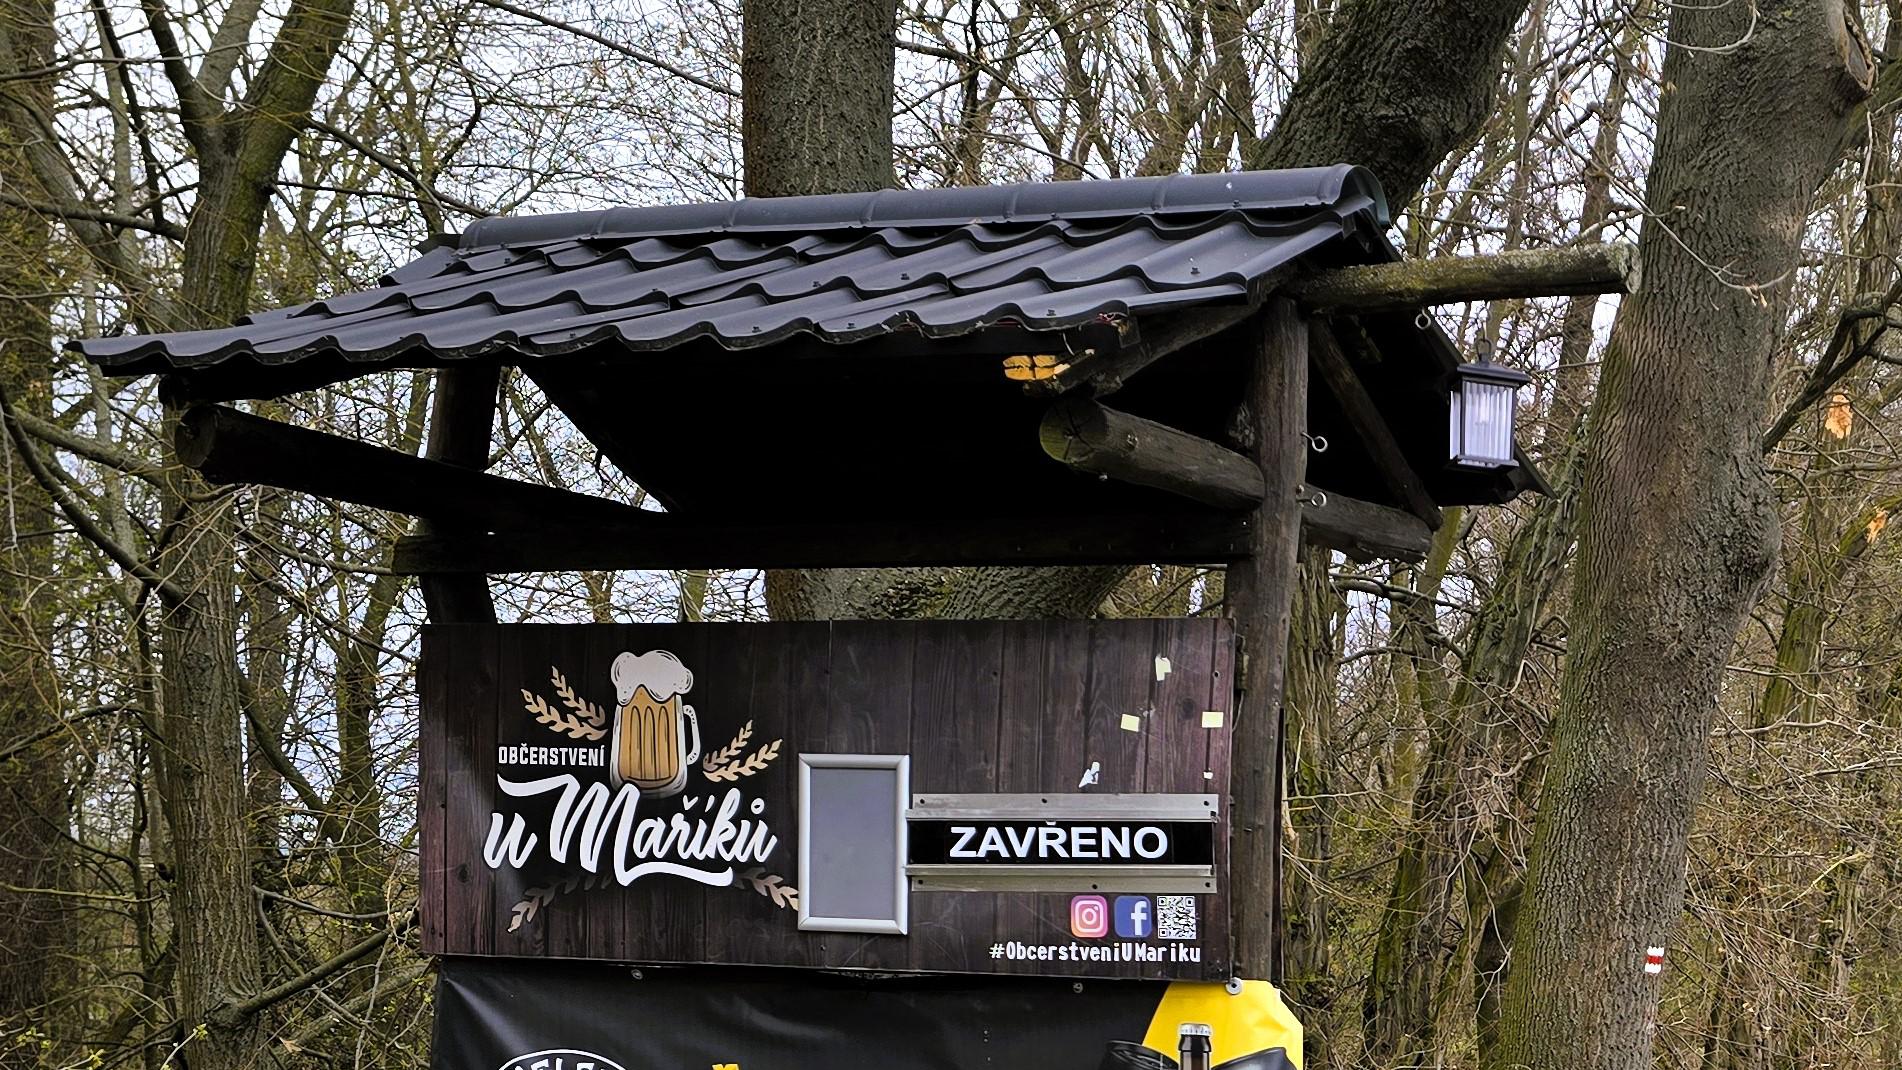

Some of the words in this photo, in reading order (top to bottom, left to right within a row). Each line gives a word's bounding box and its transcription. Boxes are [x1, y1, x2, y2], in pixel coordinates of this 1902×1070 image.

[498, 742, 605, 767] OBČERSTVENÍ
[483, 812, 538, 869] u
[497, 774, 778, 887] Maříků
[949, 820, 1168, 859] ZAVŘENO
